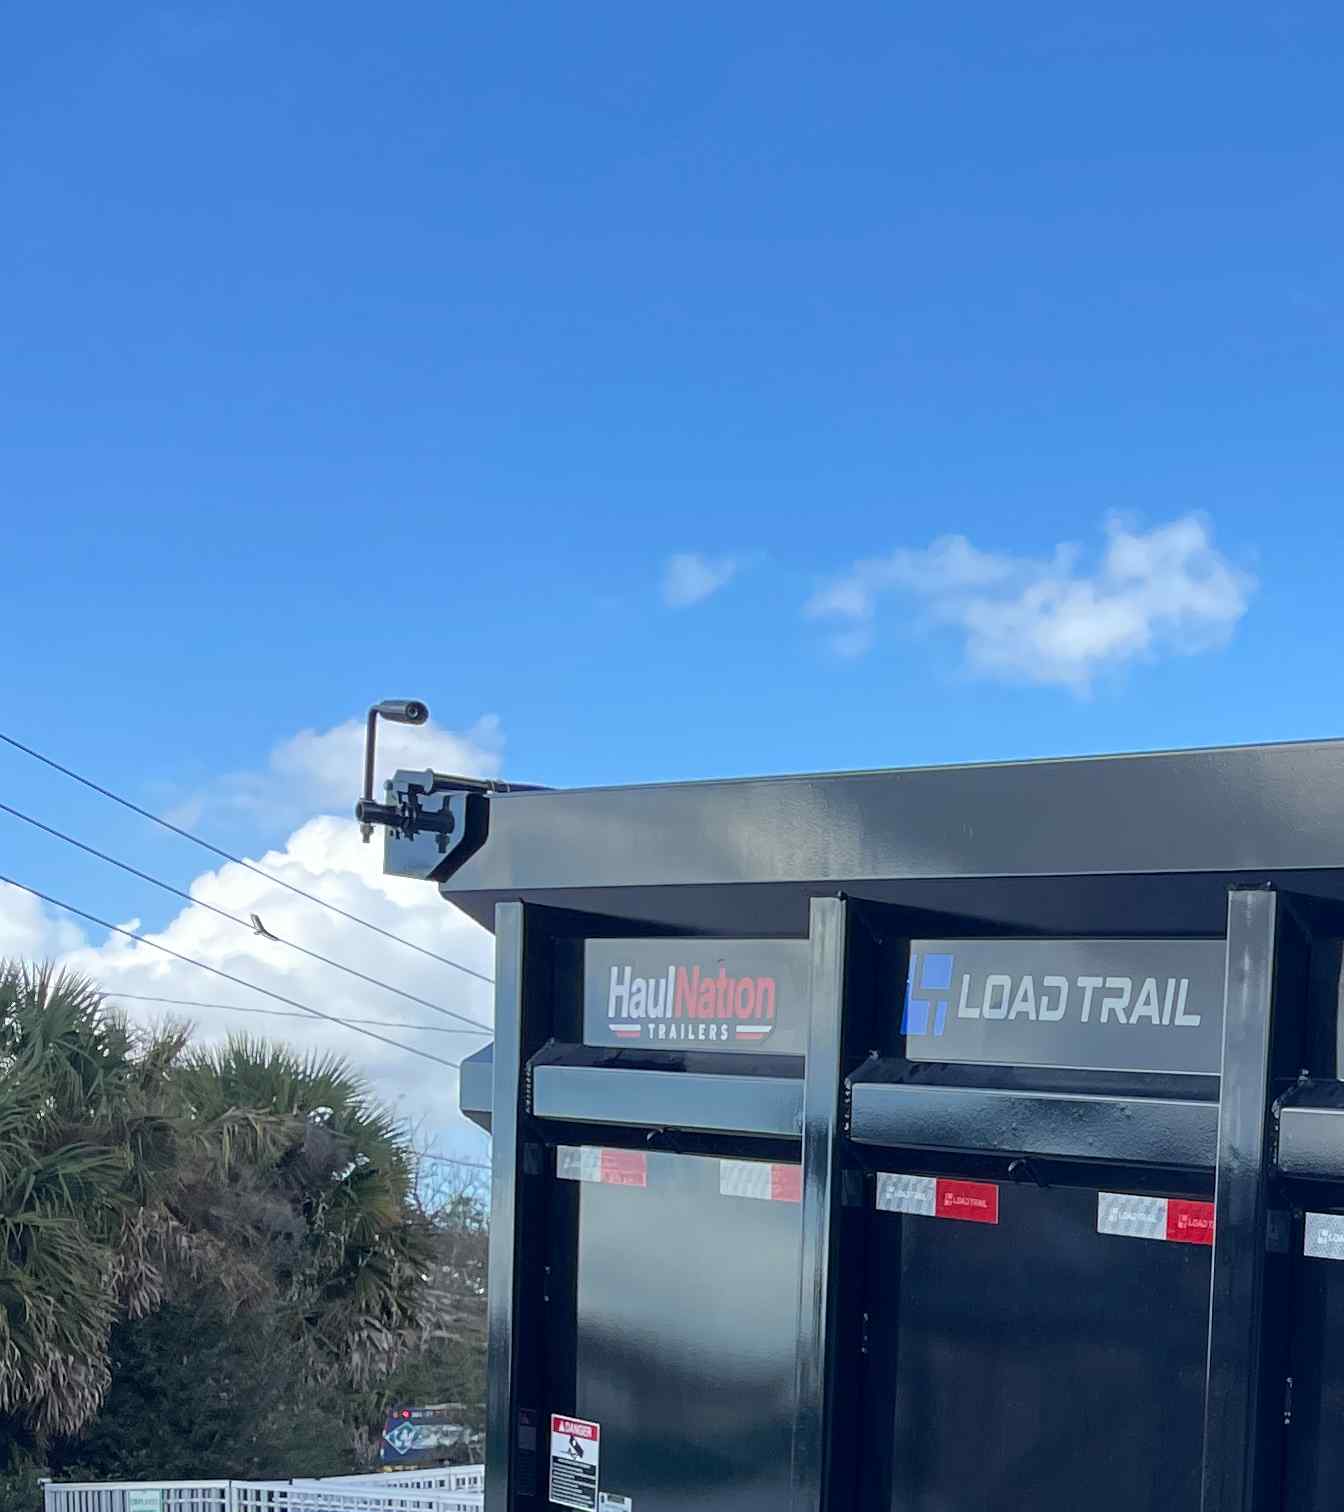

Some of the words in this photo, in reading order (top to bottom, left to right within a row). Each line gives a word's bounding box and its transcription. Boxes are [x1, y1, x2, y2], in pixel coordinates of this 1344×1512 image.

[607, 962, 776, 1018] HaulNation
[957, 974, 1069, 1021] LOAD
[1076, 976, 1201, 1027] TRAIL
[648, 1023, 729, 1041] TRAILERS
[565, 1422, 593, 1438] DANGER
